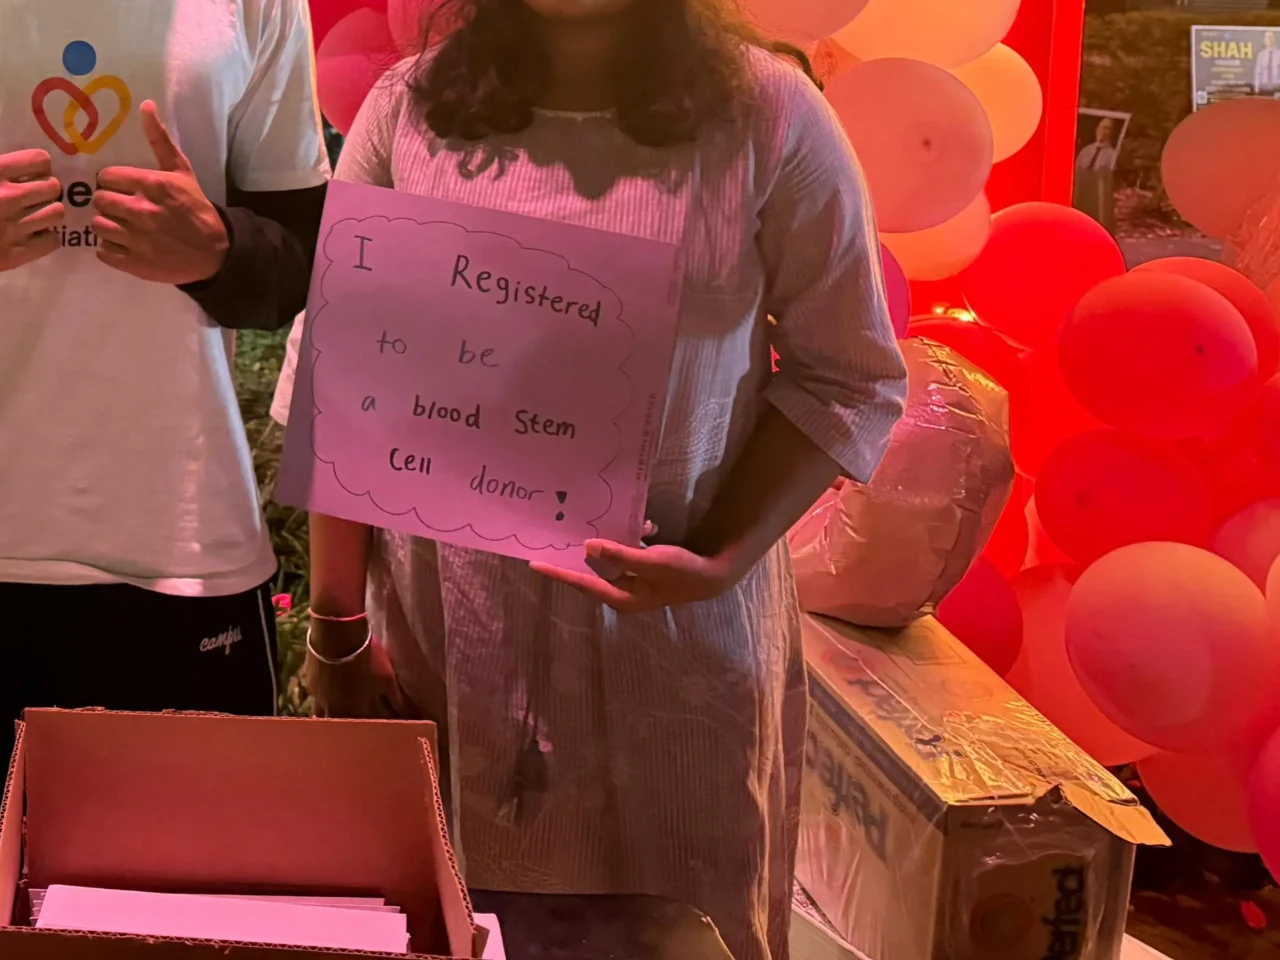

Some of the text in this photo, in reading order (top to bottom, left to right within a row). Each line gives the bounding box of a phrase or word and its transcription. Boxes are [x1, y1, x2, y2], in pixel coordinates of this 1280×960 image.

[1200, 40, 1254, 59] SHAH
[352, 235, 602, 327] I Registered
[375, 330, 500, 368] to be
[361, 393, 576, 440] a blood Stem
[804, 727, 890, 864] Perfec
[1040, 865, 1085, 960] erfect
